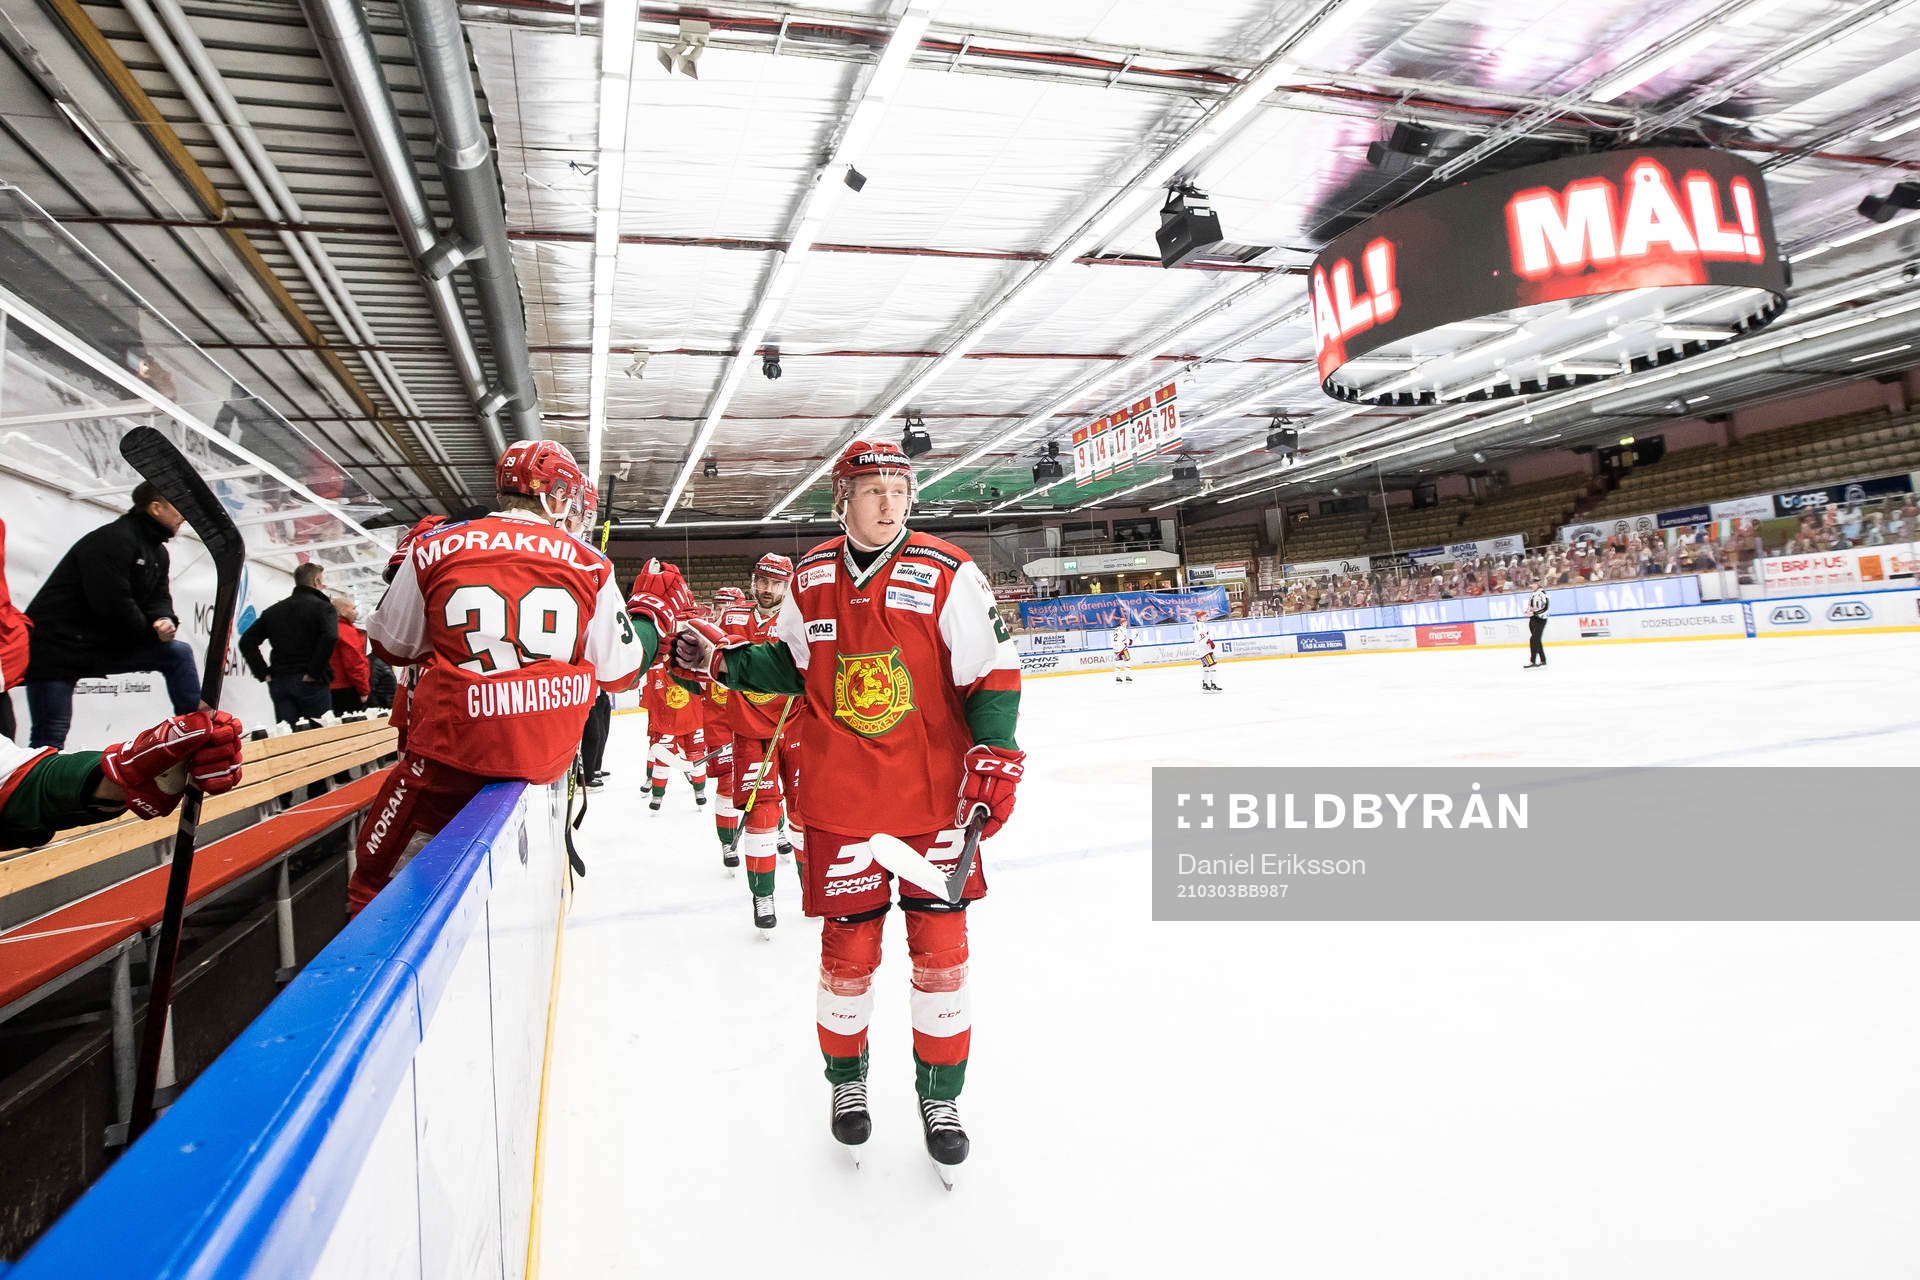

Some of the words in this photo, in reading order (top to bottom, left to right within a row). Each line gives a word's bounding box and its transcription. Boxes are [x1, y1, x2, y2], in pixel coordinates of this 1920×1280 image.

[1512, 163, 1762, 275] MÅL!
[1313, 244, 1394, 355] ÅL!
[1160, 404, 1176, 432] 78
[1136, 417, 1152, 444] 24
[1096, 437, 1106, 461] 14
[1116, 428, 1126, 453] 17
[504, 456, 516, 467] 39
[874, 454, 910, 465] Mattsso
[1078, 447, 1085, 468] 9
[557, 468, 574, 478] CCM
[919, 548, 958, 568] Mattsson
[897, 568, 933, 580] dalakraft
[444, 584, 579, 678] 39
[1641, 615, 1736, 629] CO2REDUCERA.SE
[1020, 655, 1059, 664] OHNS
[1080, 655, 1115, 665] MORAK
[467, 673, 592, 719] GUNNARSSON
[896, 671, 909, 705] KLUBB
[849, 713, 898, 731] ISHOCKEY
[975, 759, 1024, 777] CC
[132, 798, 159, 816] CCM
[824, 872, 882, 890] JOHNS
[825, 880, 882, 897] SPORT
